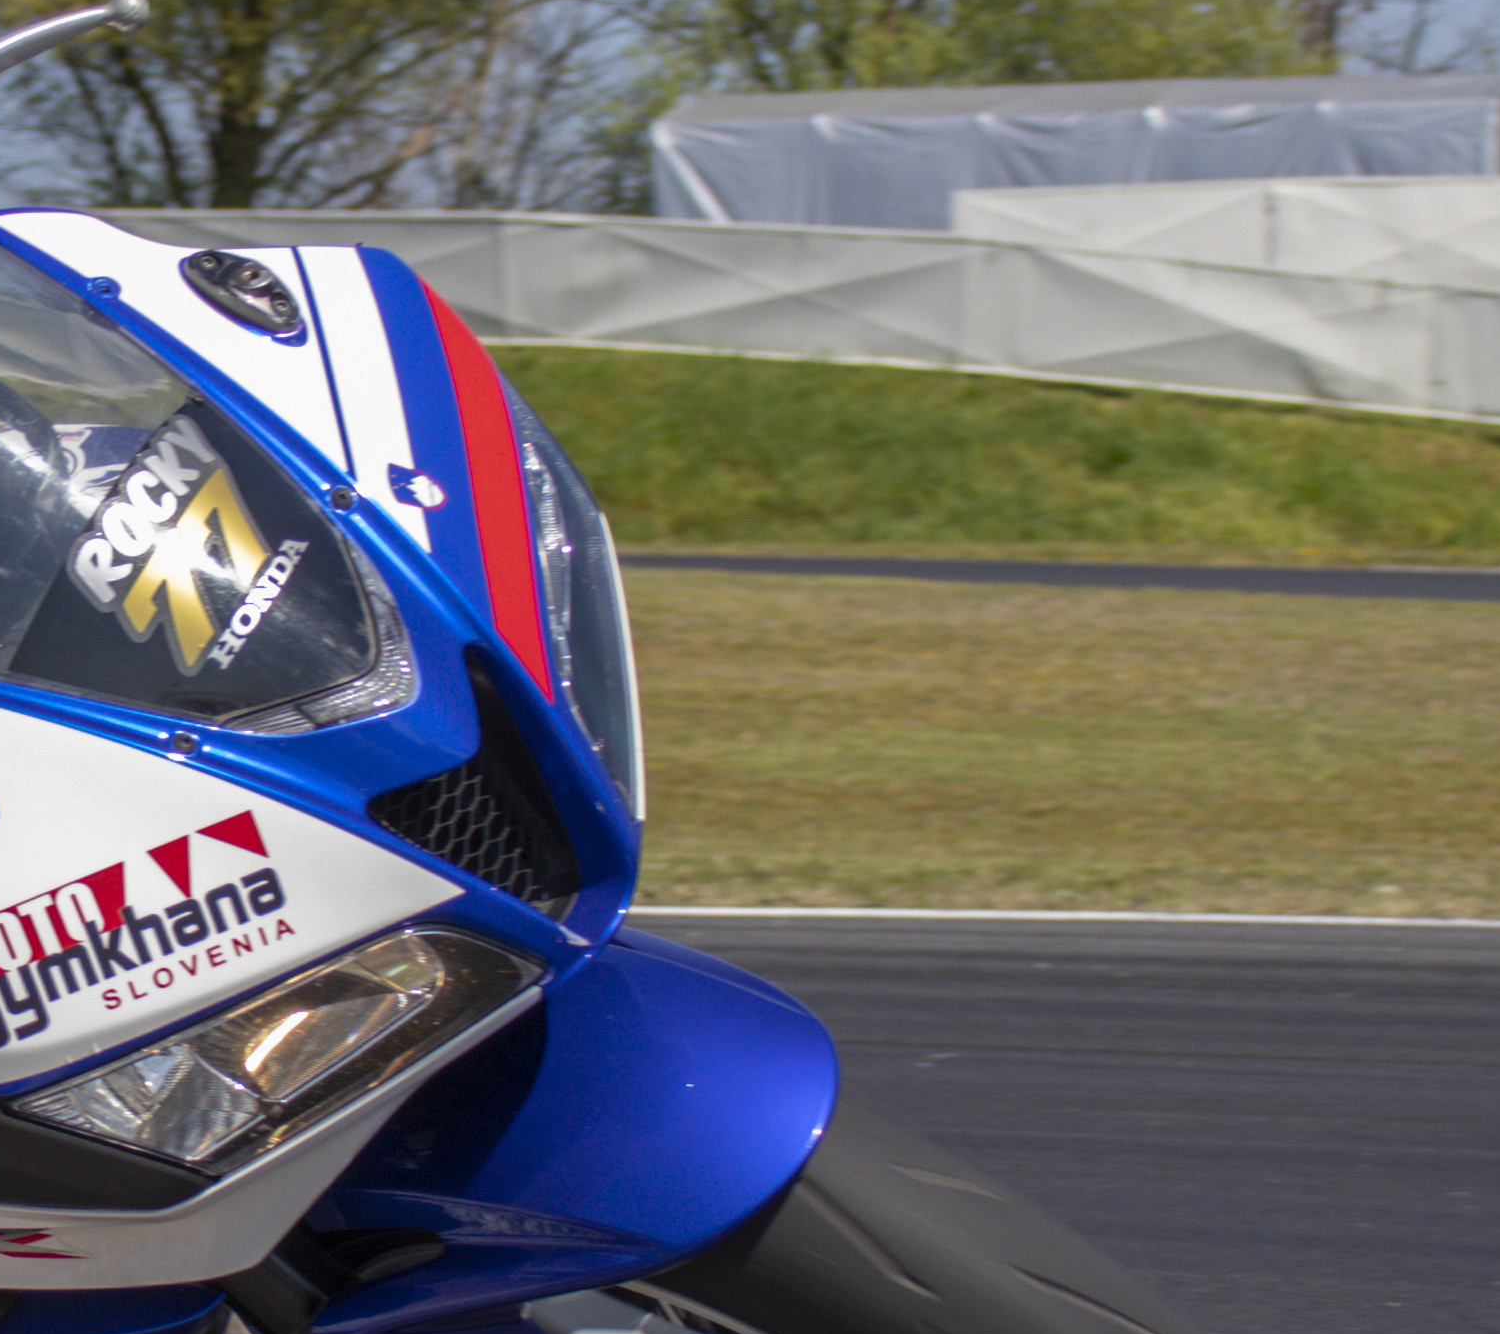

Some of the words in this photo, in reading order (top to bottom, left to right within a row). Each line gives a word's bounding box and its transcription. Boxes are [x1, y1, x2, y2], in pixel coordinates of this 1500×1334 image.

[74, 419, 217, 604] ROCKY
[207, 538, 310, 669] HONDA
[101, 918, 296, 1010] SLOVENIA
